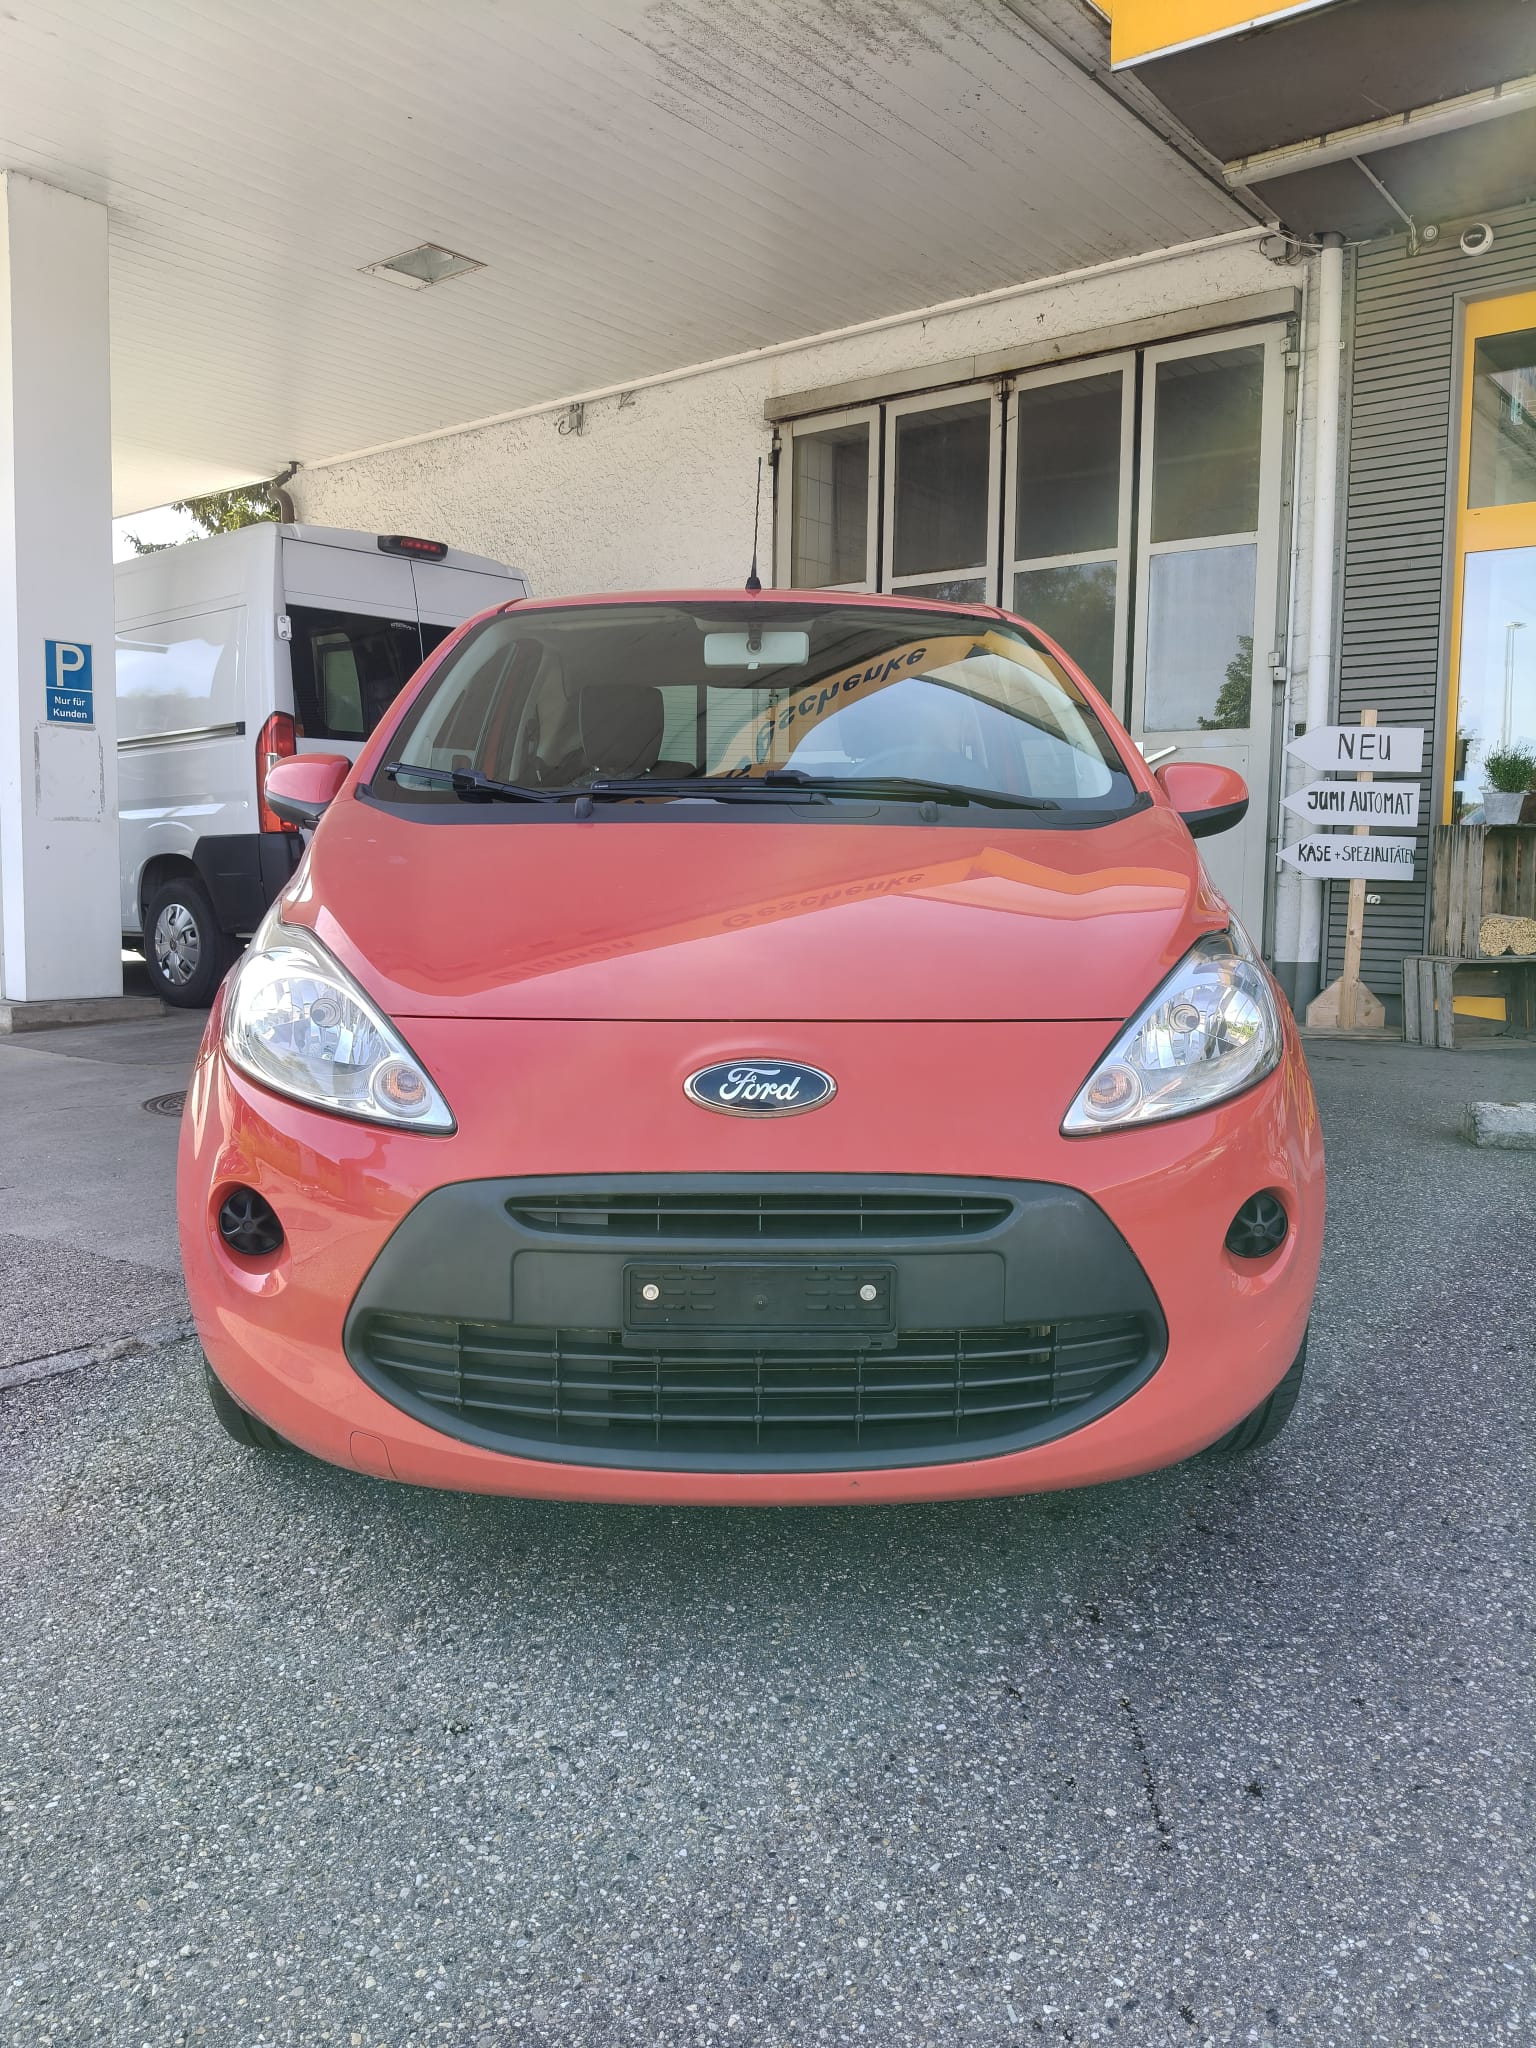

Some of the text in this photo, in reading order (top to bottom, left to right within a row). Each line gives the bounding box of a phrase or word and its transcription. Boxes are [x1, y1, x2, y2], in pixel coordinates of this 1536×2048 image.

[55, 642, 85, 687] P
[53, 708, 88, 719] Kunden
[54, 695, 86, 707] Nur für
[1337, 733, 1391, 761] NEU
[1307, 790, 1415, 815] JUMI AUTOMAT
[1298, 842, 1332, 863] KÄSE
[719, 1067, 802, 1101] Ford
